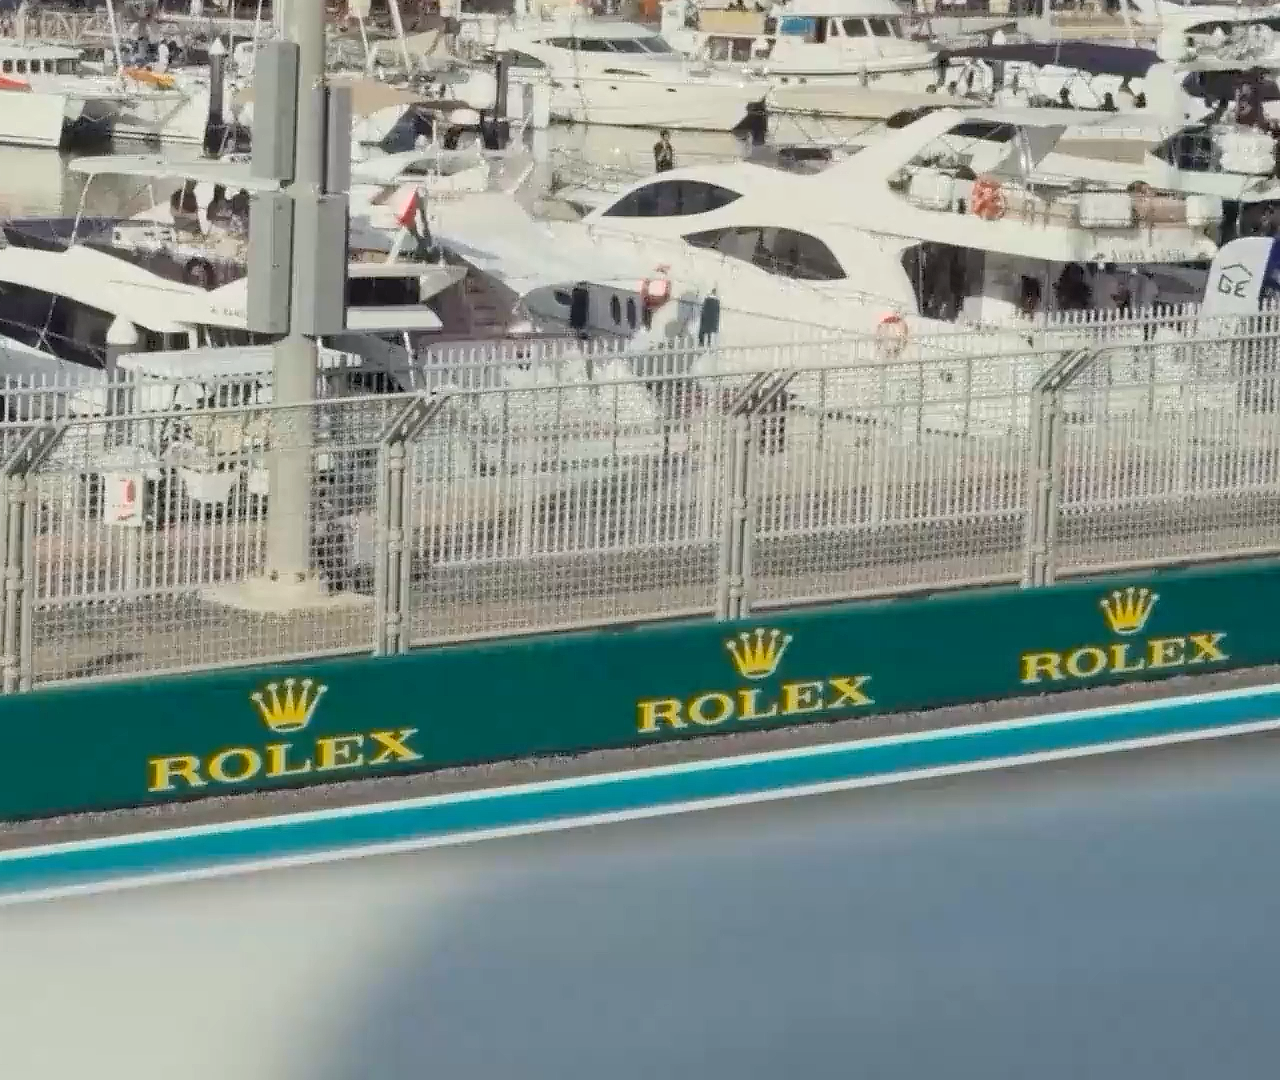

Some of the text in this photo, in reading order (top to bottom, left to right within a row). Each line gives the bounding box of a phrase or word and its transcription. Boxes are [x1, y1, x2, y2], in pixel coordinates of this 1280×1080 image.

[1020, 632, 1230, 684] ROLEX
[636, 675, 876, 734] ROLEX
[147, 728, 424, 793] ROLEX
